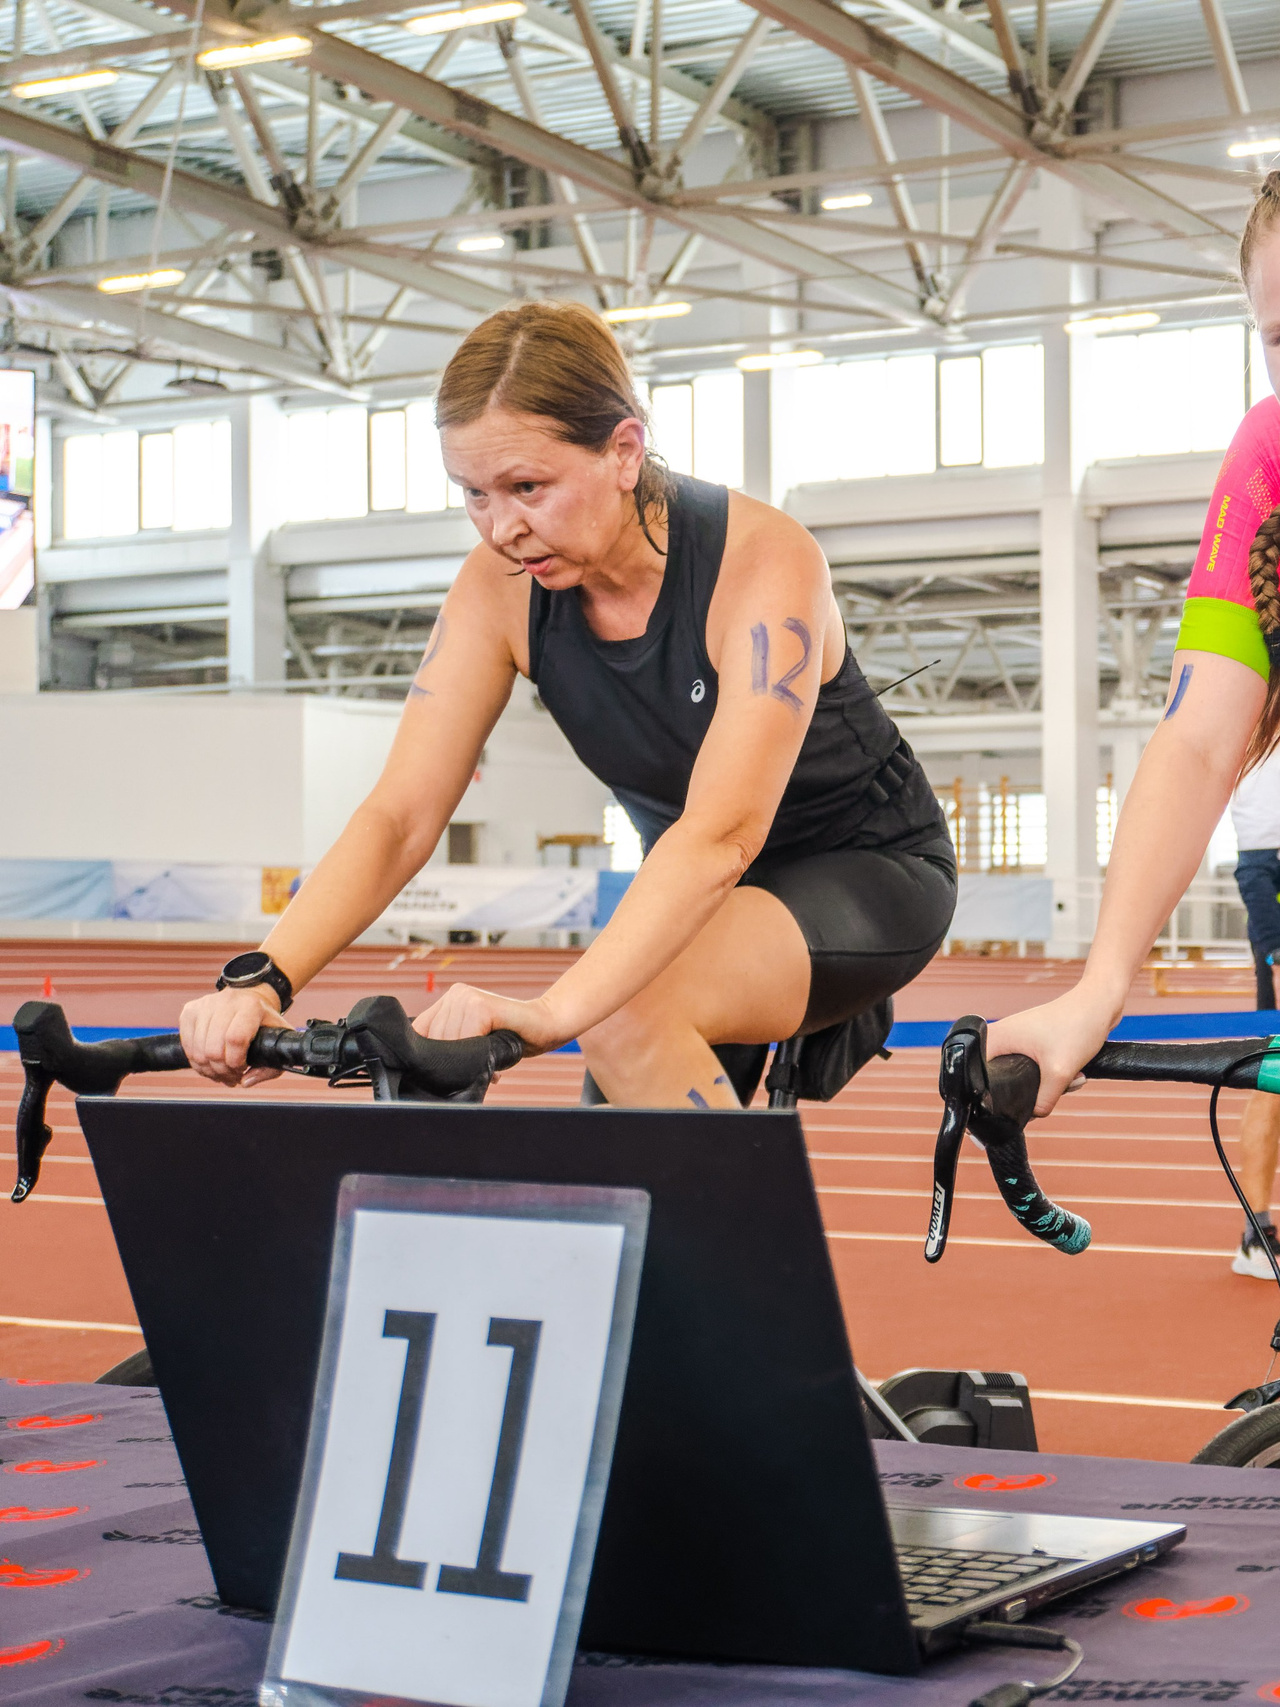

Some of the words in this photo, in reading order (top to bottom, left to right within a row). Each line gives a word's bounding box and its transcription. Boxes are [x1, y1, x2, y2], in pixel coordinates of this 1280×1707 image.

[1216, 494, 1231, 529] MAD
[1205, 533, 1223, 572] WAVE
[750, 617, 811, 712] 12
[334, 1309, 542, 1603] 11
